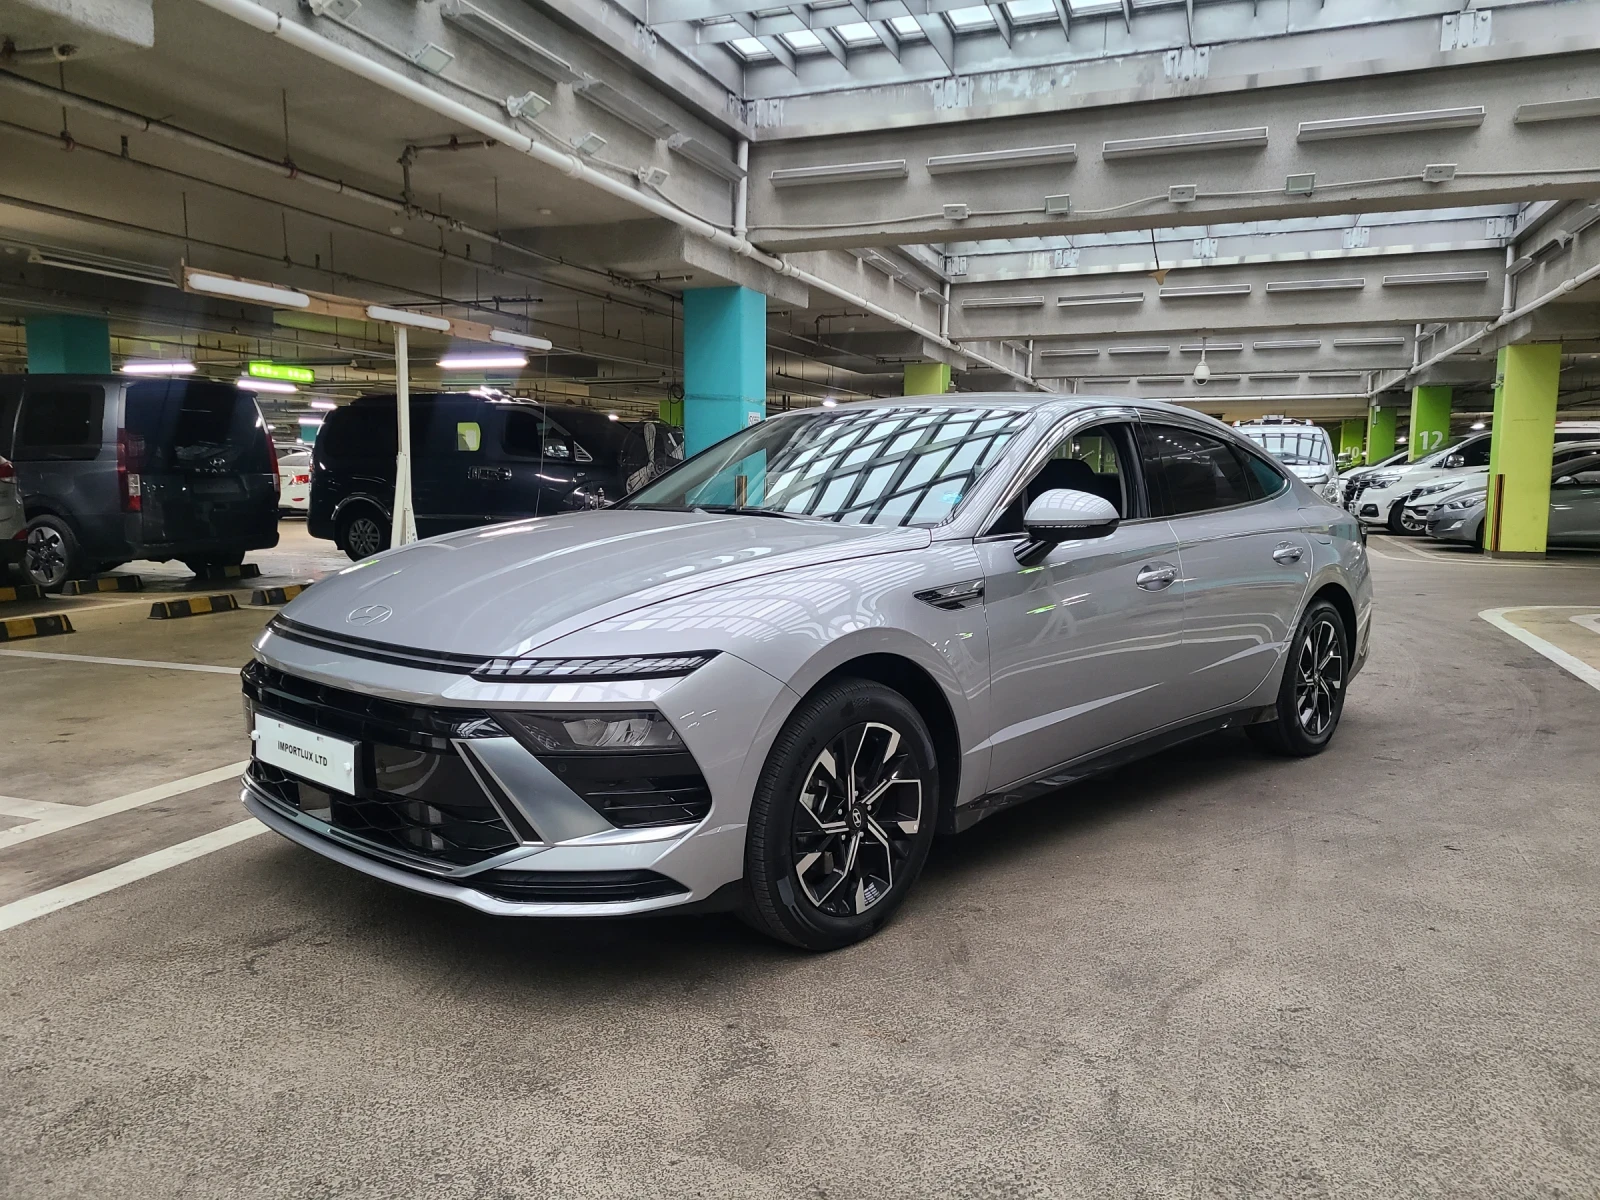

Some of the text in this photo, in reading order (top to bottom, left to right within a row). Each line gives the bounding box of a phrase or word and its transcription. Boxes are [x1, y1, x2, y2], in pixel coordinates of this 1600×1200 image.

[1420, 431, 1443, 450] 12
[277, 741, 328, 767] IMPORTLUX LTD
